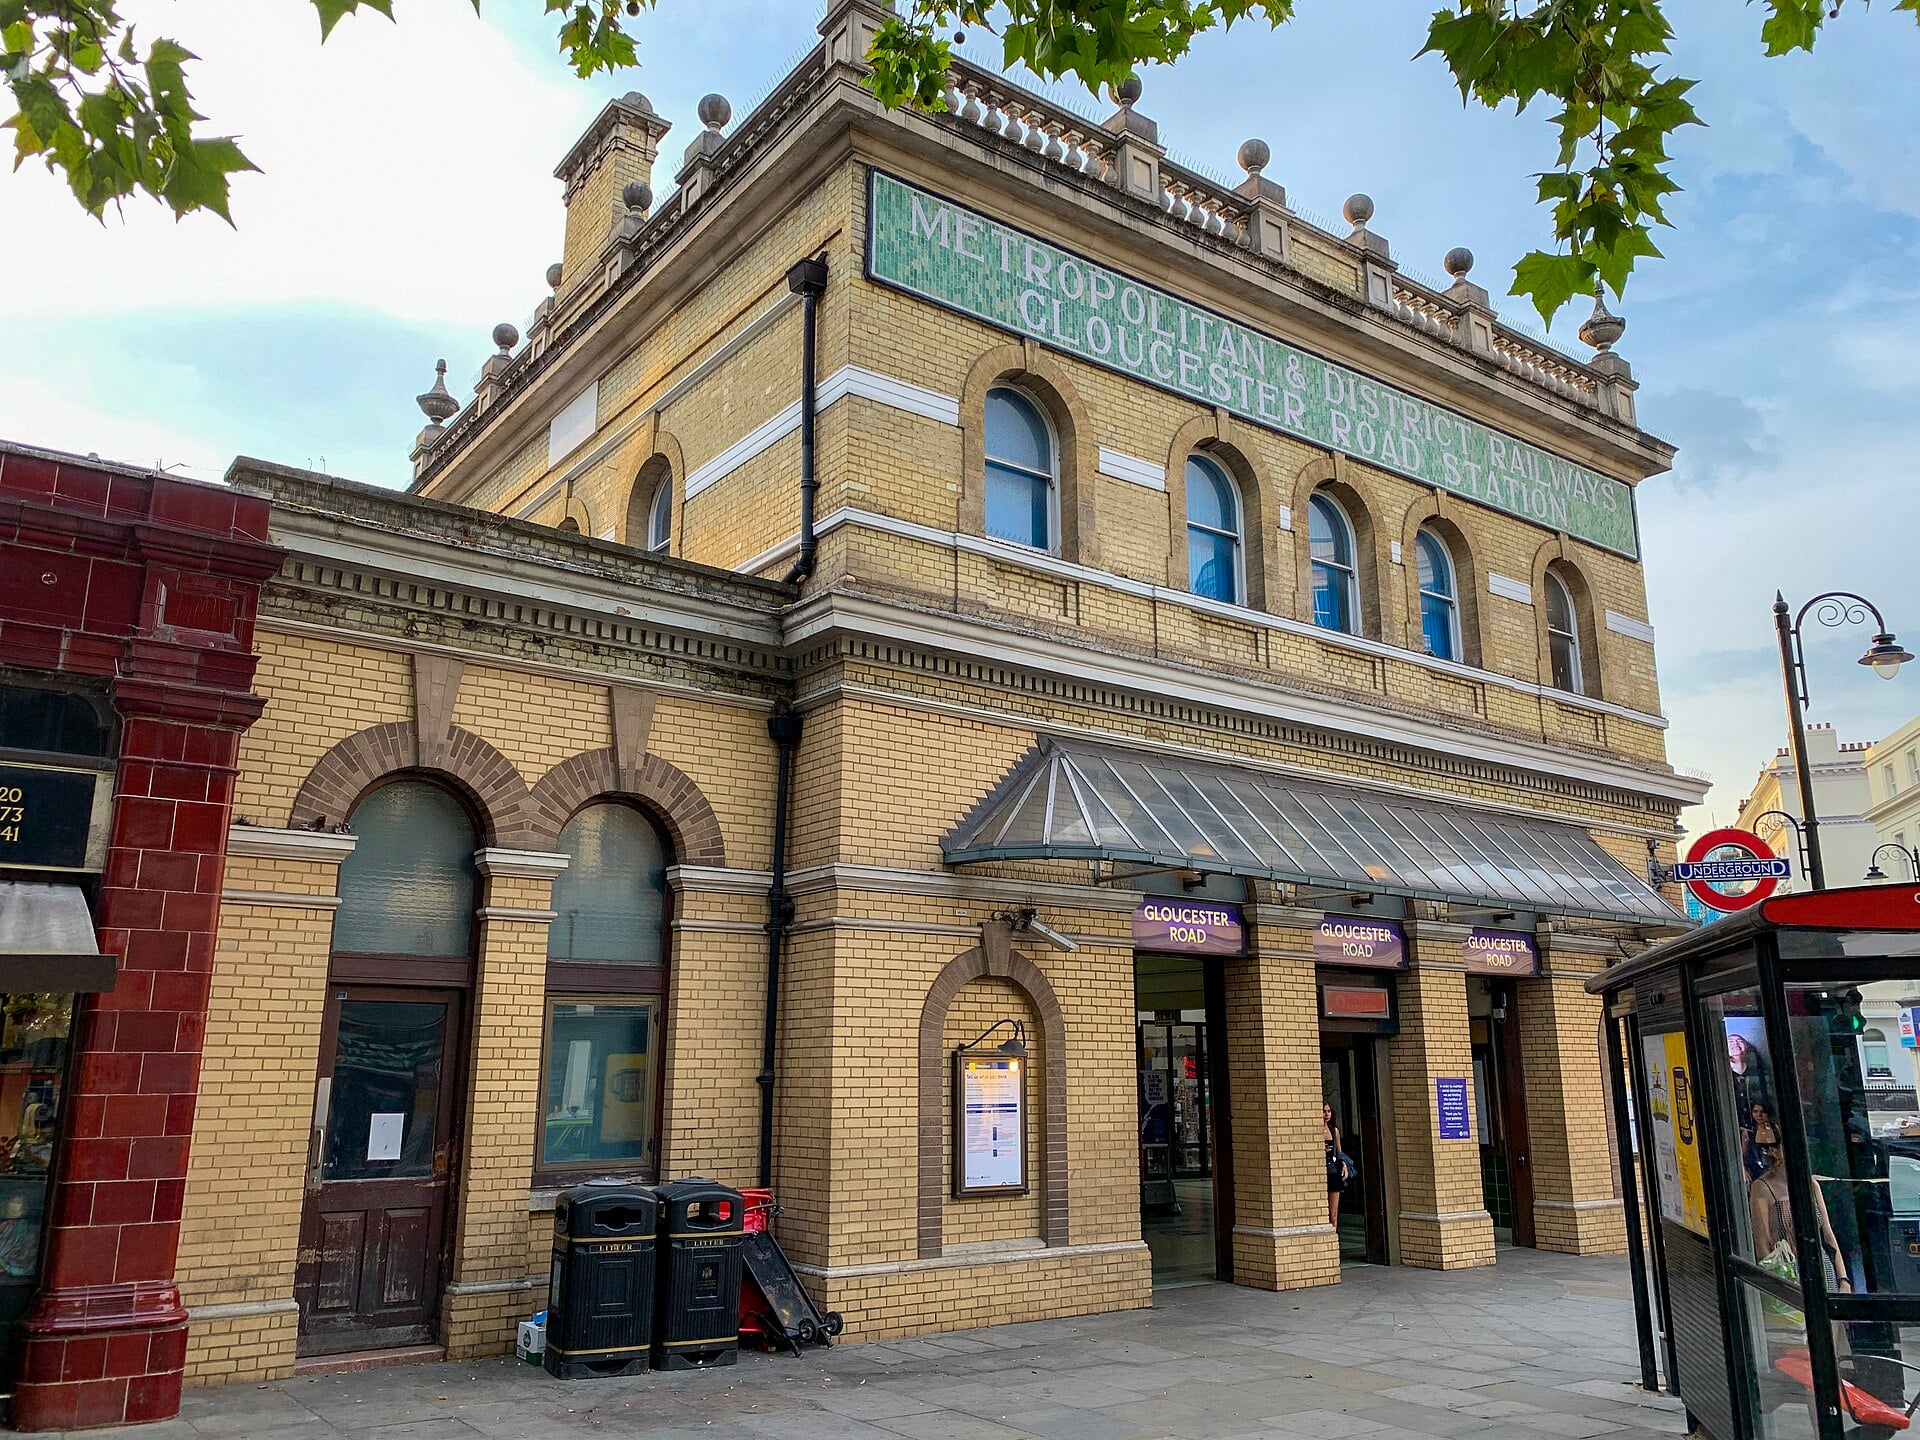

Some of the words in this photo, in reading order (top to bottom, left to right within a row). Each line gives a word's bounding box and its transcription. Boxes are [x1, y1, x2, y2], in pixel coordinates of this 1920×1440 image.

[910, 194, 1265, 375] METROPOLITAN
[1286, 355, 1307, 391] &
[1324, 366, 1471, 455] DISTRICT
[1489, 435, 1617, 513] RAILWAYS
[1020, 289, 1305, 430] GLOUCESTER
[1331, 409, 1421, 472] ROAD
[1445, 451, 1568, 526] STATION
[1678, 861, 1786, 879] UNDERGROUND
[1144, 905, 1230, 927] GLOUCESTER
[1169, 927, 1207, 944] ROAD
[1320, 923, 1392, 943] GLOUCESTER
[1342, 943, 1374, 958] ROAD
[1467, 936, 1528, 952] GLOUCESTER
[1486, 953, 1513, 968] ROAD
[694, 1239, 724, 1247] LITTER
